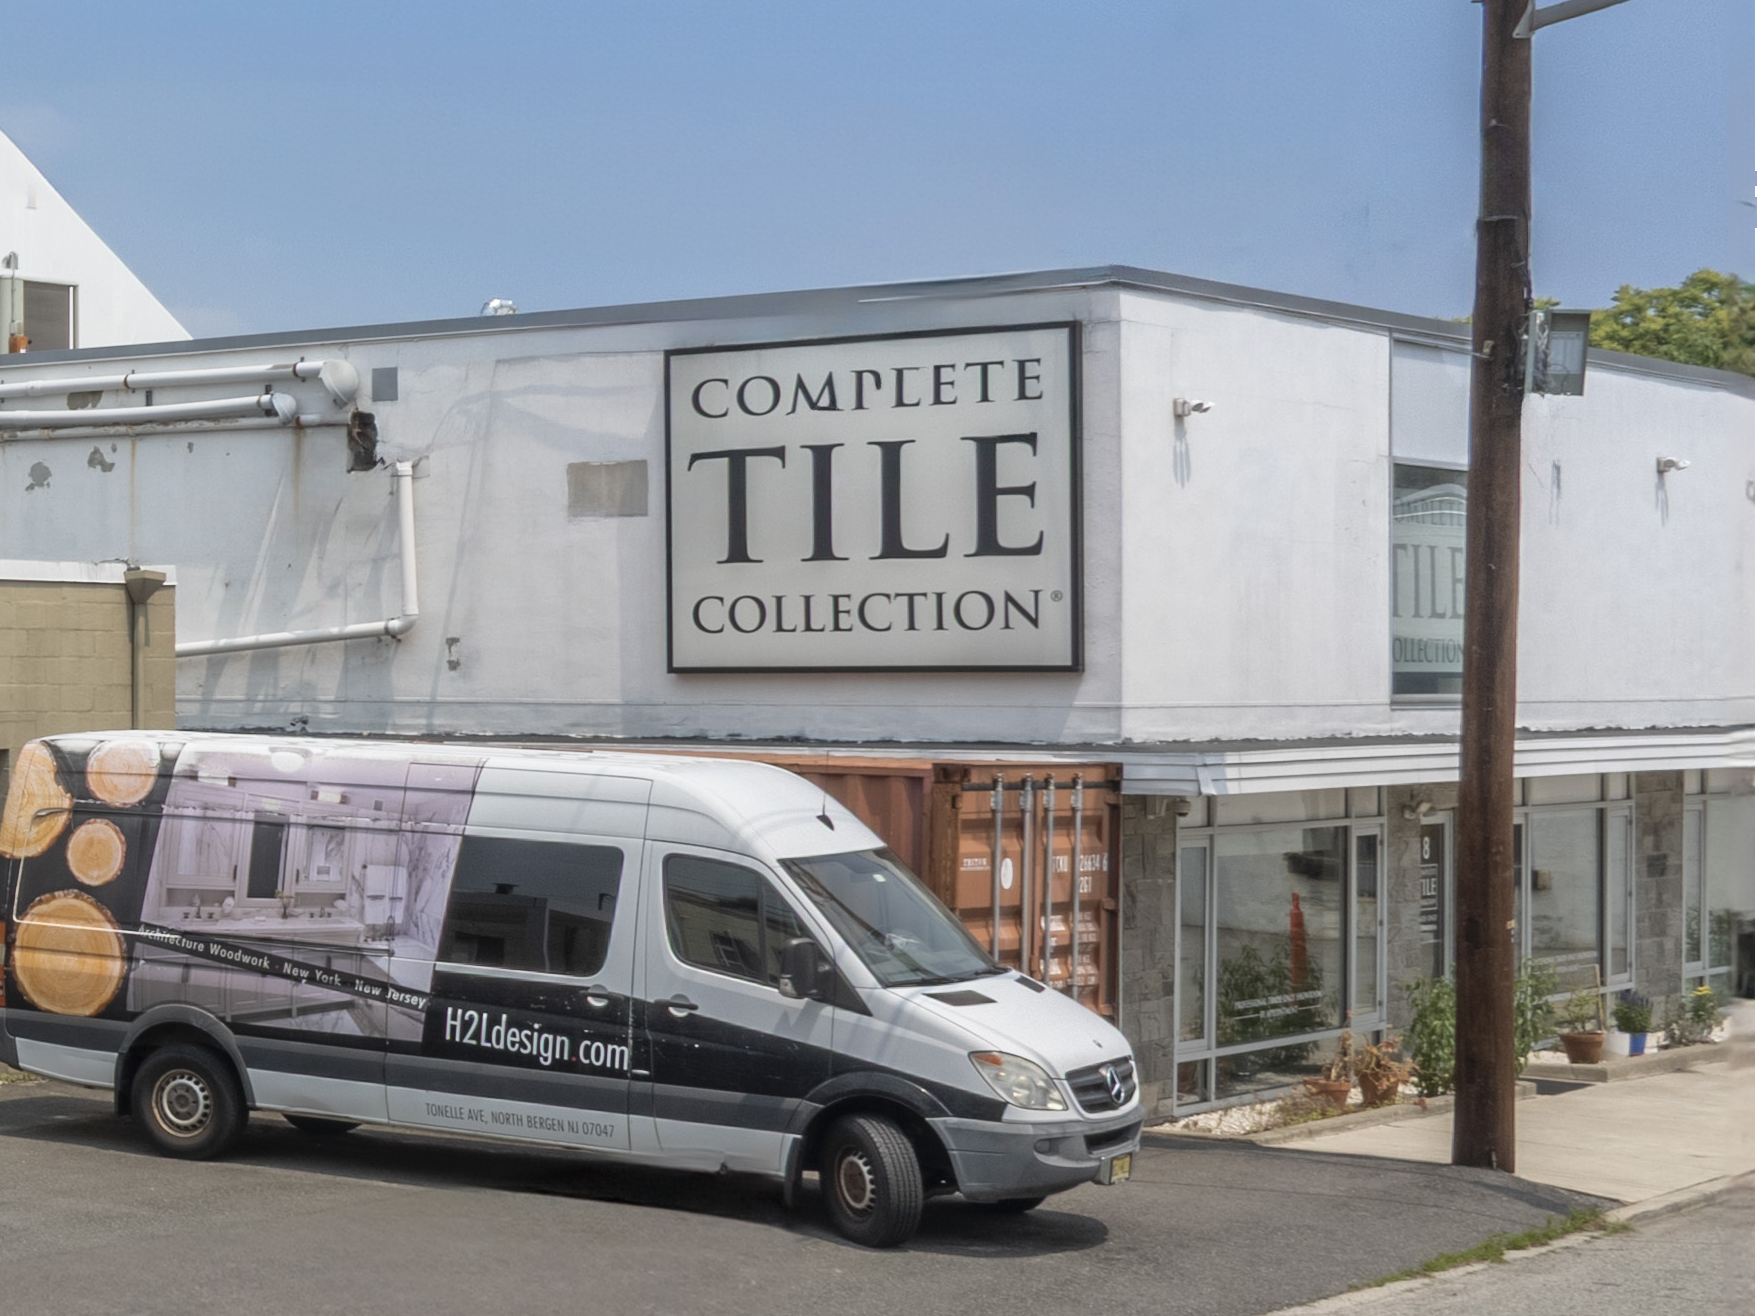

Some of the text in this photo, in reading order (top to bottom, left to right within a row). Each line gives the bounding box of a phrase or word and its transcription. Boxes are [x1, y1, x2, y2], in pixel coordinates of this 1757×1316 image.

[690, 358, 1044, 419] COMPLETE
[687, 431, 1044, 565] TILE
[209, 942, 270, 970] Woodwork
[283, 962, 310, 979] New
[314, 969, 342, 987] York
[354, 979, 383, 996] New
[386, 986, 426, 1009] Jersey
[445, 1006, 631, 1071] H2Ldesign.com
[425, 1102, 615, 1138] TONELLE AVE, NORTH BERGEN NJ 07047
